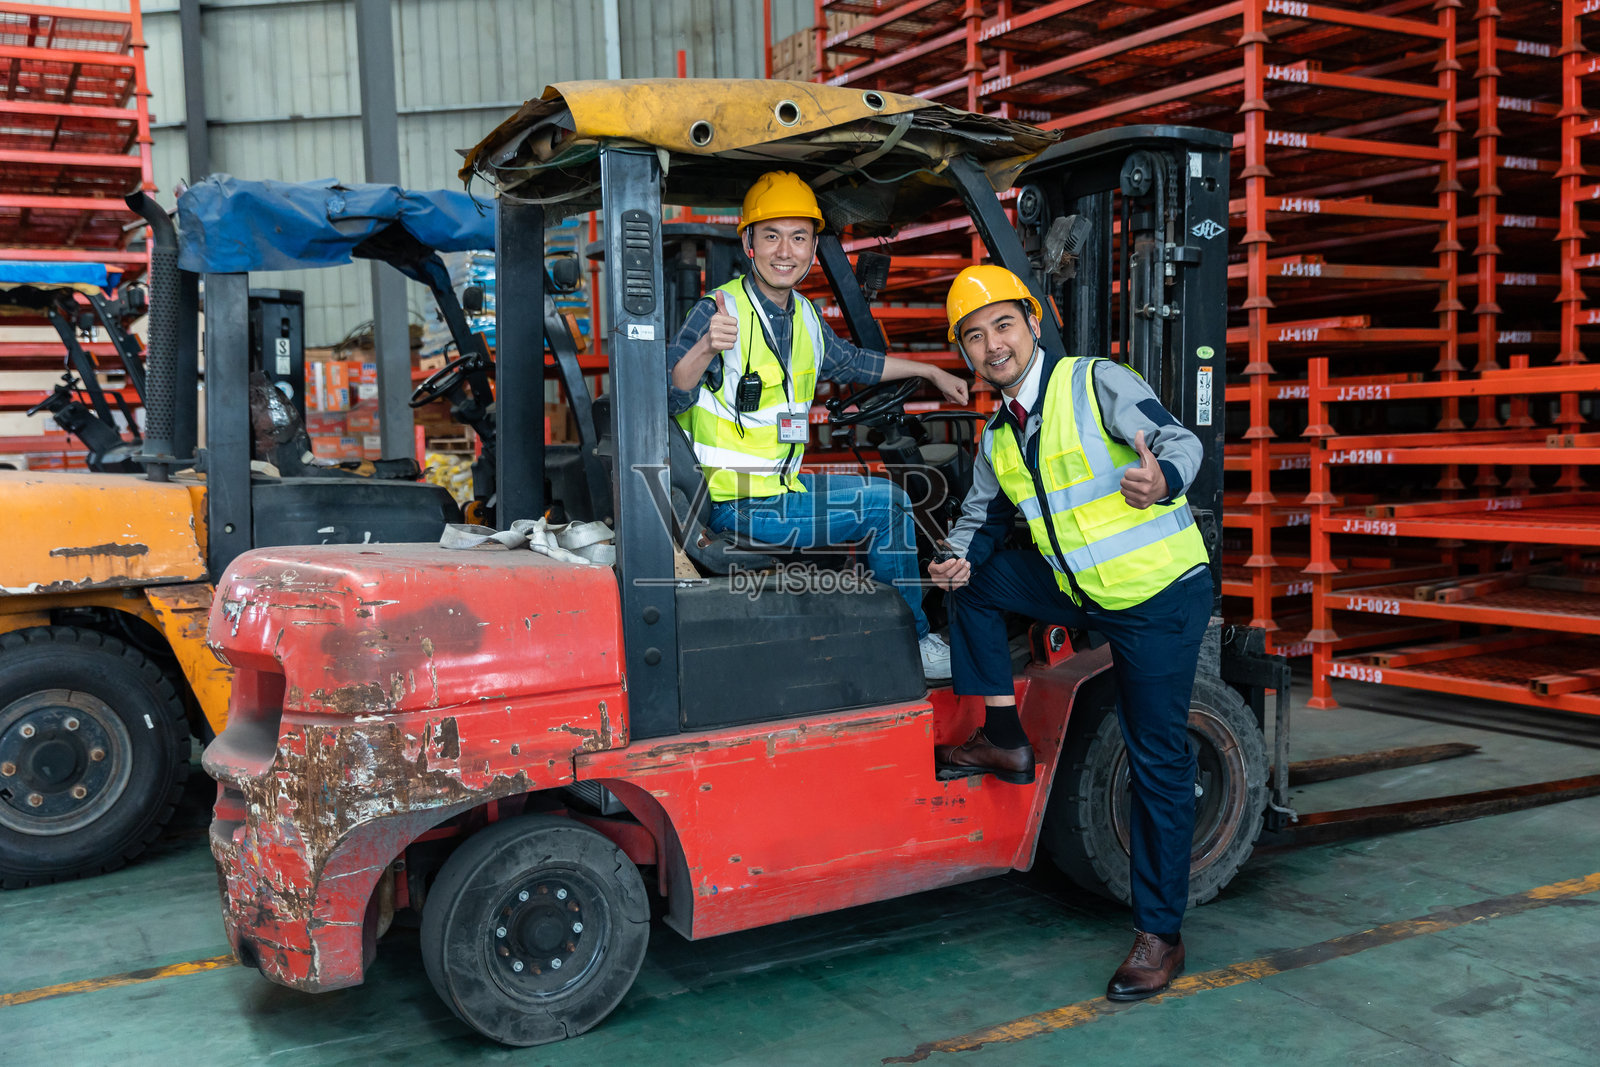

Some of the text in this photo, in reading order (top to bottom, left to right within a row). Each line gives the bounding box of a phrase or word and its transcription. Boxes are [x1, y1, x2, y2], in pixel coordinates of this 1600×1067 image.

[1266, 0, 1309, 17] JJ-0202
[1266, 65, 1309, 83] JJ-0203
[1265, 129, 1308, 148] JJ-0204
[1281, 263, 1321, 277] JJ-0196
[1278, 327, 1319, 341] JJ-0197
[1337, 385, 1390, 401] JJ-0521
[1328, 449, 1382, 464] JJ-0290
[1342, 519, 1397, 536] JJ-0593
[1346, 597, 1400, 615] JJ-0023
[1329, 663, 1383, 684] JJ-0339
